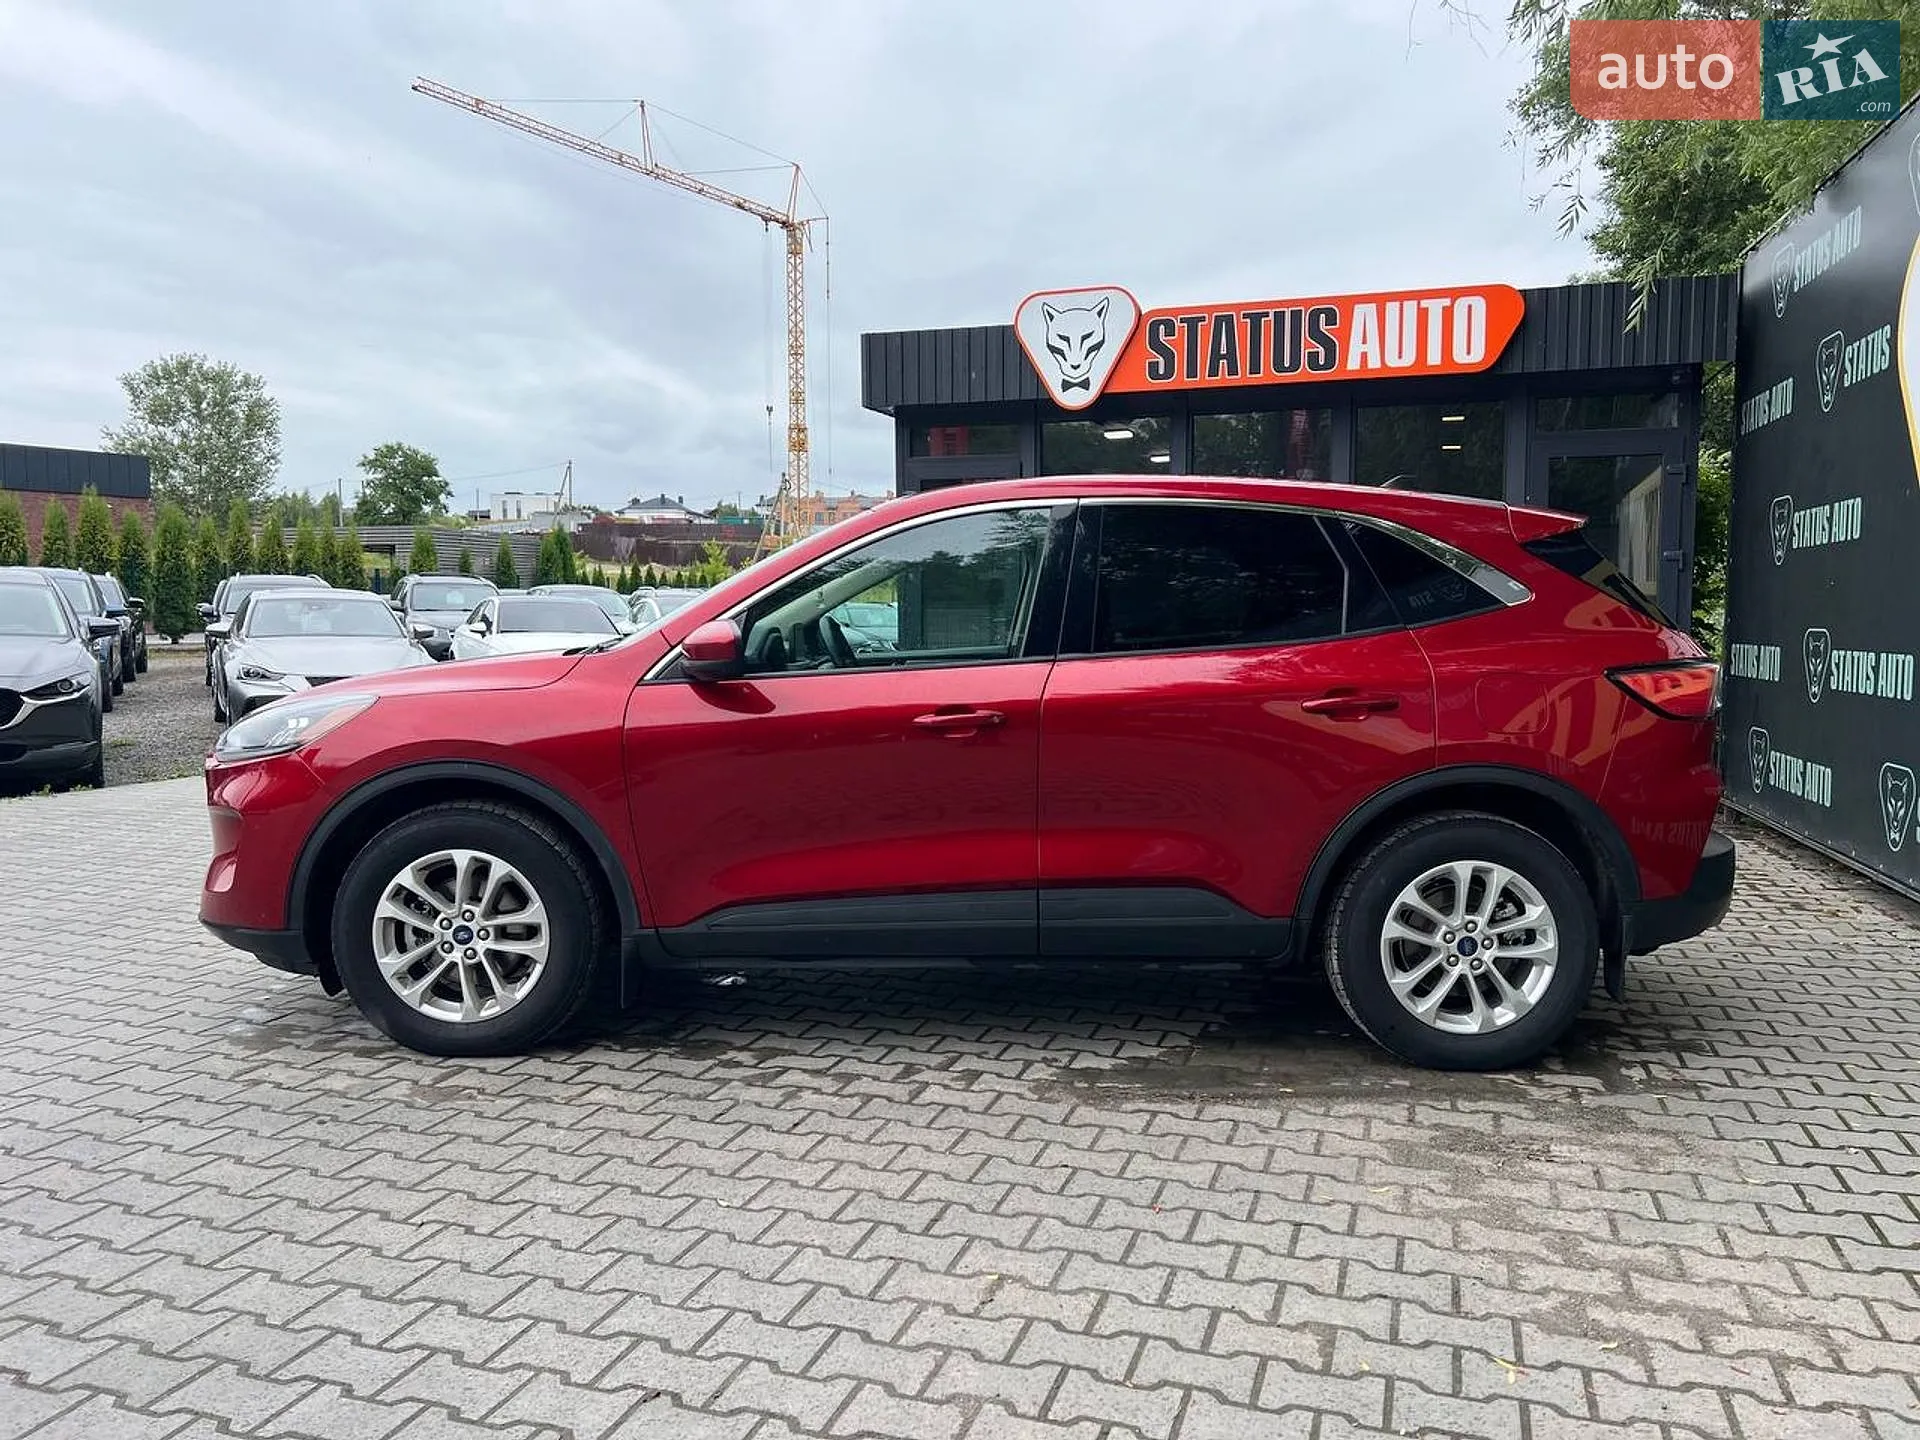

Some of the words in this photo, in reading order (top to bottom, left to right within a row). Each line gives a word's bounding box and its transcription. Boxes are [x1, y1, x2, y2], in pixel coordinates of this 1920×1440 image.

[1793, 228, 1831, 293] STATUS
[1831, 205, 1861, 266] AUTO
[1145, 305, 1340, 384] STATUS
[1346, 295, 1487, 371] AUTO
[1843, 324, 1891, 388] STATUS
[1740, 390, 1770, 436] STATUS
[1770, 376, 1794, 423] AUTO
[1792, 504, 1830, 549] STATUS
[1831, 497, 1862, 543] AUTO
[1730, 643, 1758, 679] STATUS
[1758, 645, 1781, 682] AUTO
[1830, 650, 1876, 695] STATUS
[1876, 653, 1914, 701] AUTO
[1769, 750, 1803, 796] STATUS
[1804, 762, 1832, 808] AUTO
